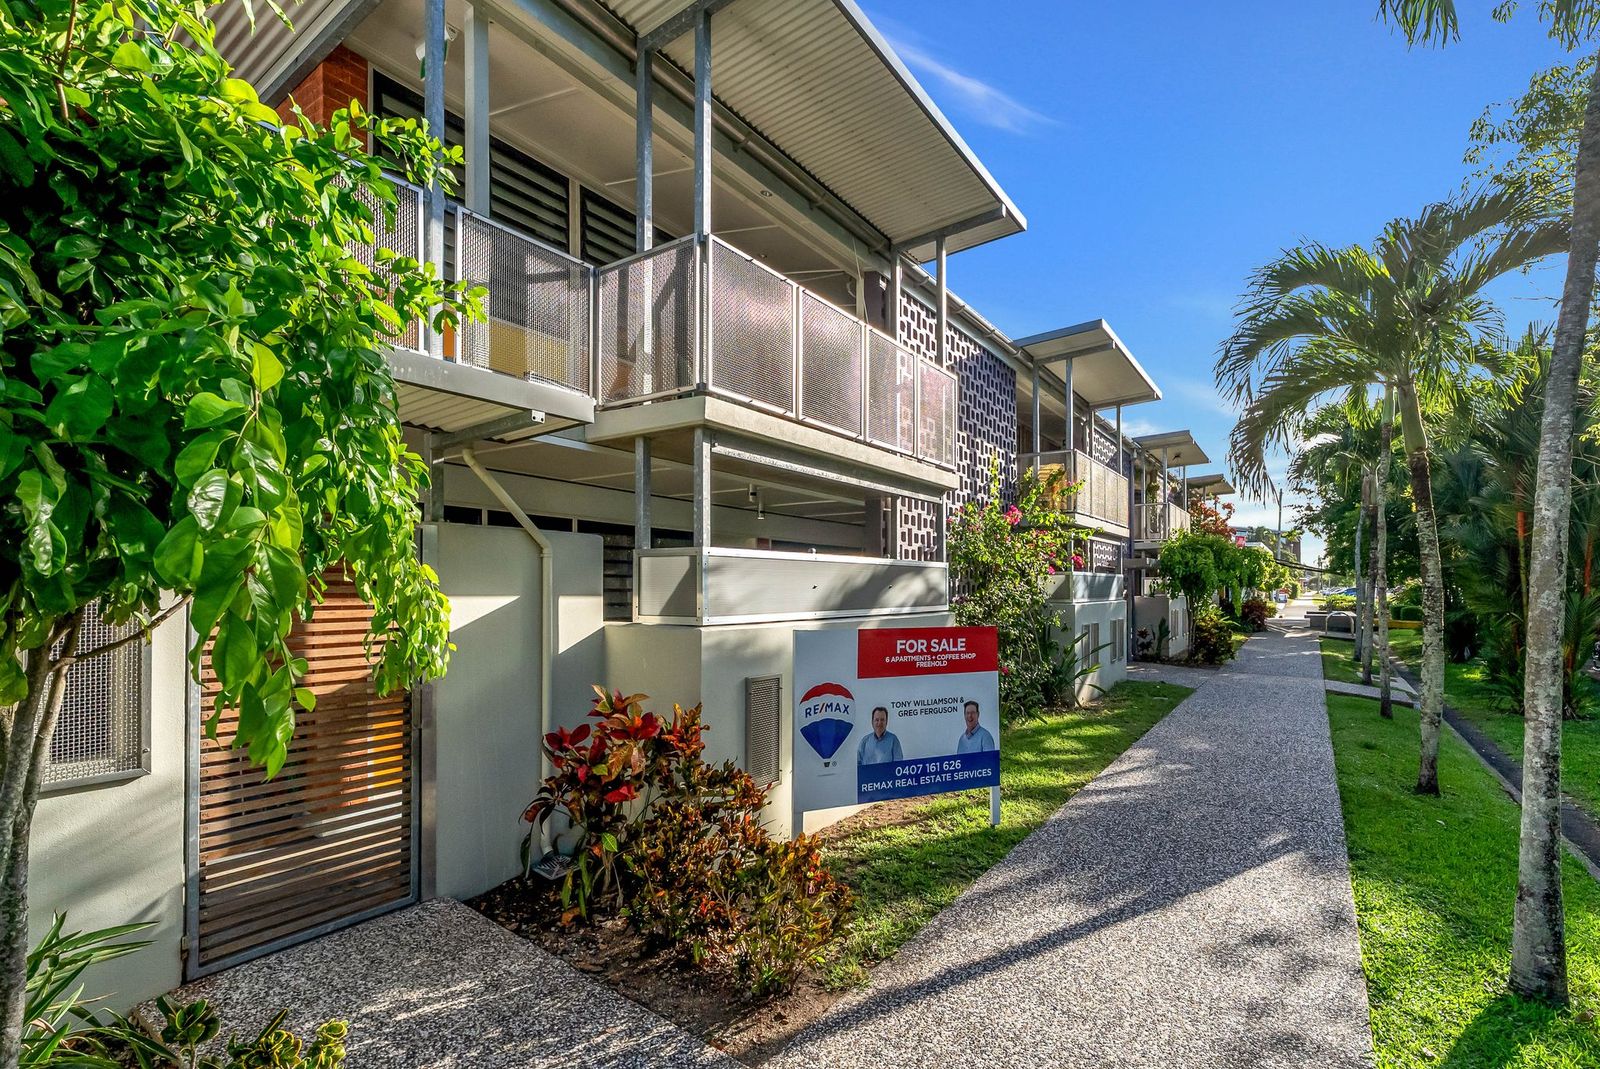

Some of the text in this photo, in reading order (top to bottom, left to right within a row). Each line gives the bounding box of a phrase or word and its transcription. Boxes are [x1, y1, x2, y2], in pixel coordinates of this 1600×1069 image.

[896, 638, 966, 653] FOR SALE
[913, 698, 958, 706] WILLIAMSON
[804, 702, 850, 718] RE/MAX
[920, 706, 958, 716] FERGUSON
[896, 760, 961, 776] 0407 161 626
[861, 768, 992, 792] REMAX REAL ESTATE SERVICES
